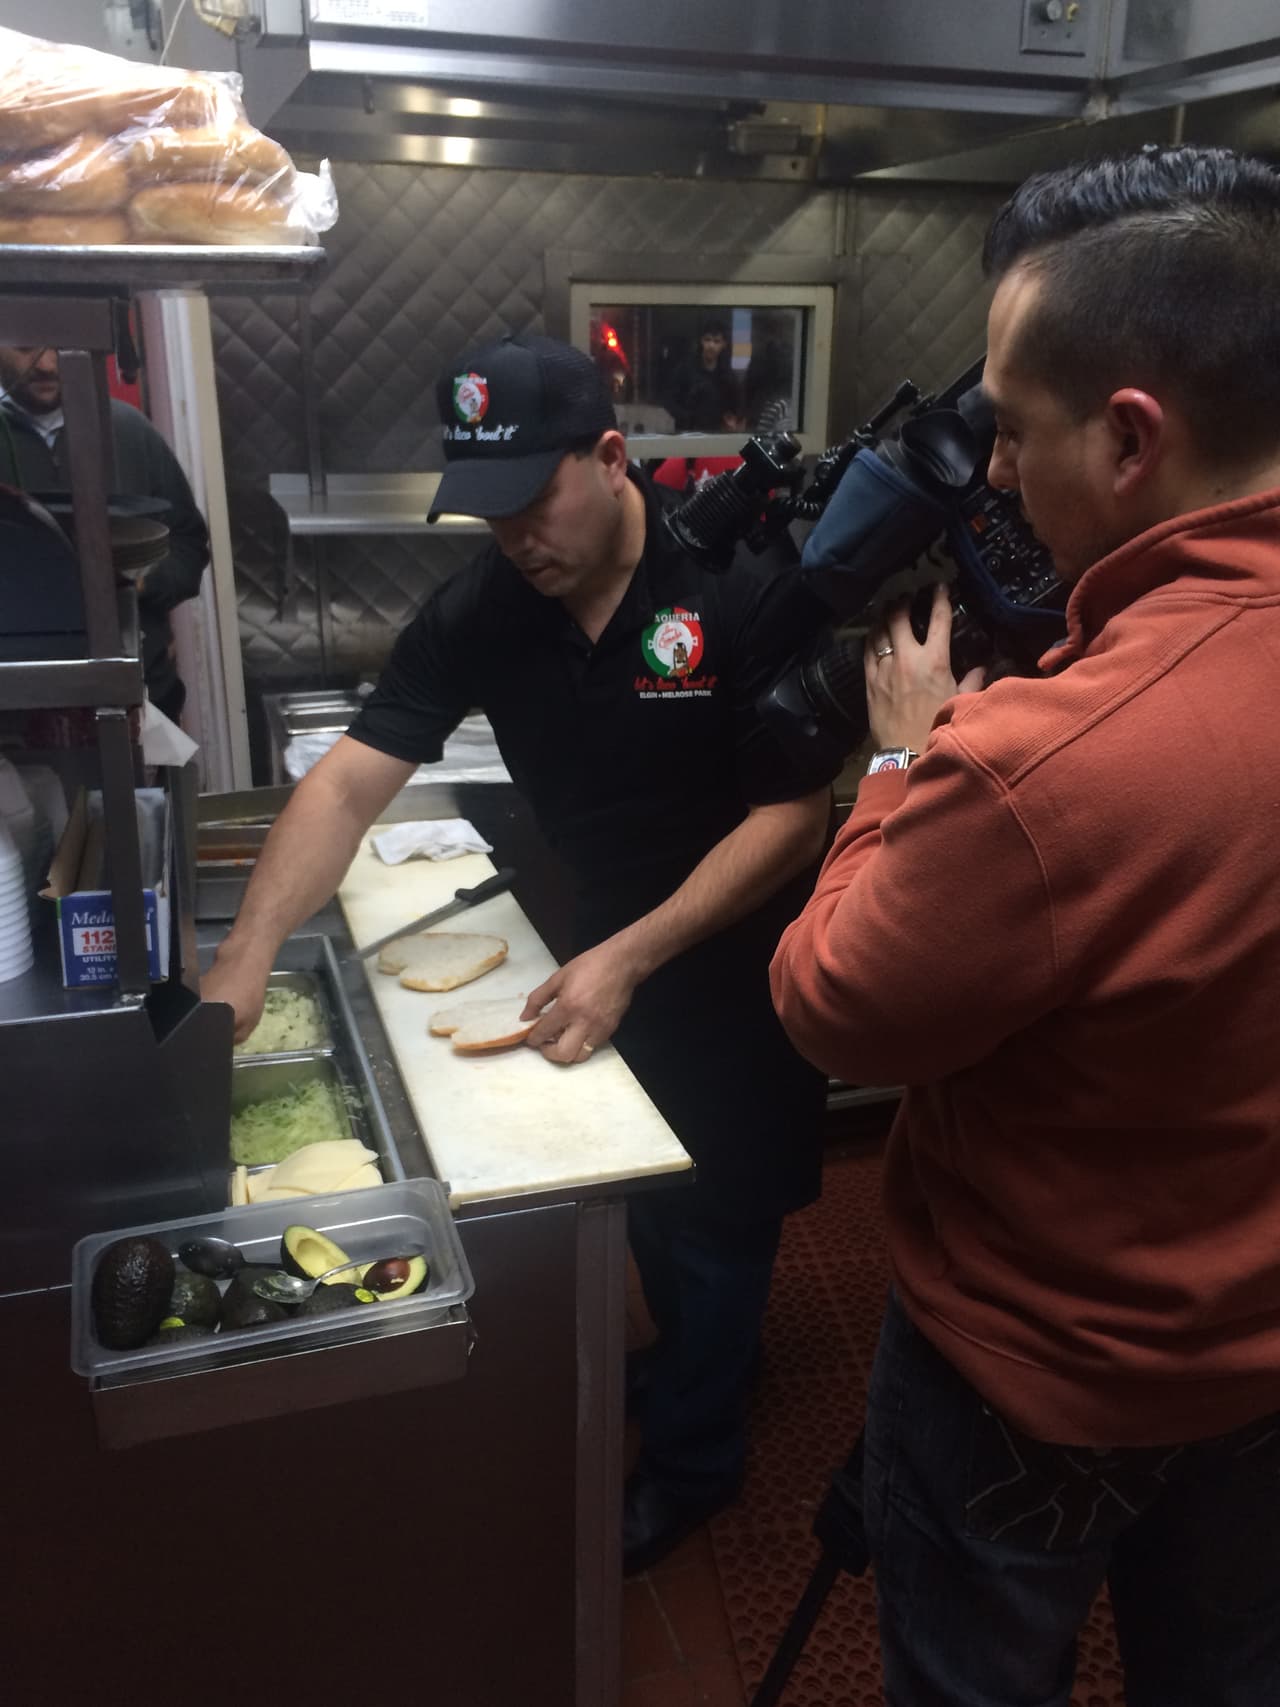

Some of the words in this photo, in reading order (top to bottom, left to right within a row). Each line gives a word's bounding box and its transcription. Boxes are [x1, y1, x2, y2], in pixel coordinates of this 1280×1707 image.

[654, 611, 700, 623] AQUERIA
[662, 690, 693, 699] MELROSE
[694, 689, 712, 697] PARK
